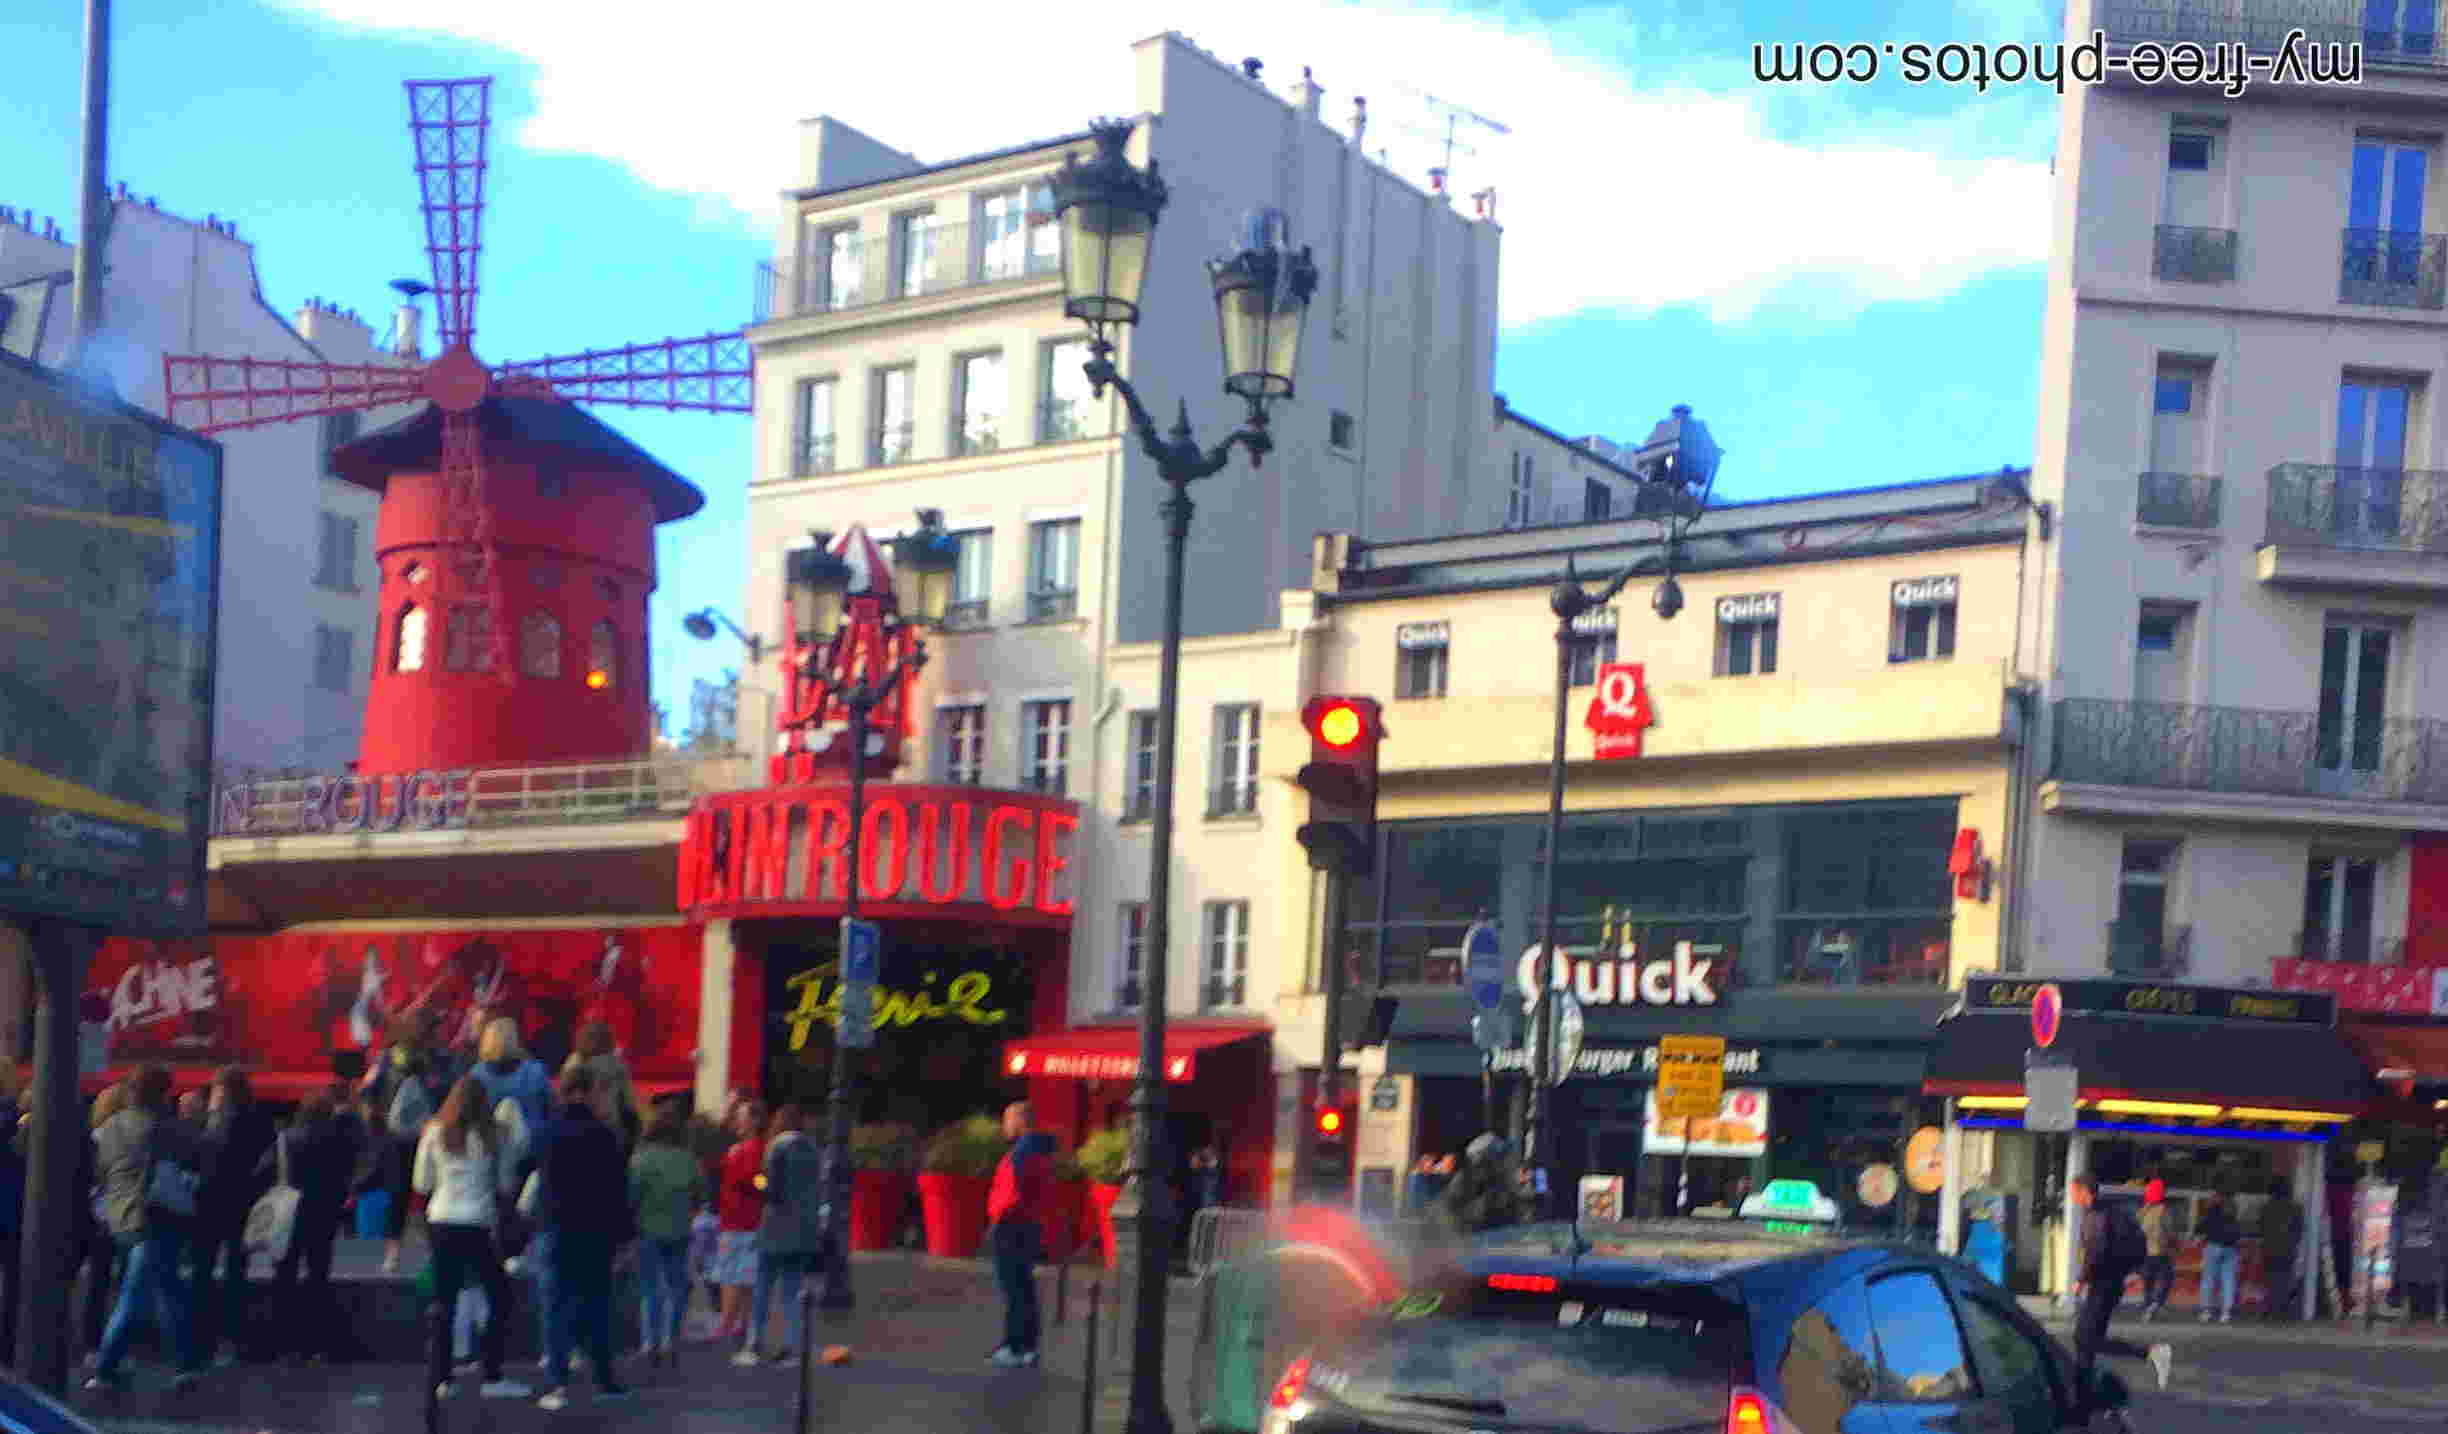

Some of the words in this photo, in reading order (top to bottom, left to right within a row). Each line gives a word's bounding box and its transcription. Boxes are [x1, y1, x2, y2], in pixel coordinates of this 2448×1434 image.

[1719, 595, 1777, 623] Quick
[1894, 578, 1956, 606] Quick
[1601, 671, 1636, 716] Q
[803, 797, 1078, 914] ROUGE
[1517, 940, 1717, 1016] Quick
[1576, 1048, 1636, 1076] urger
